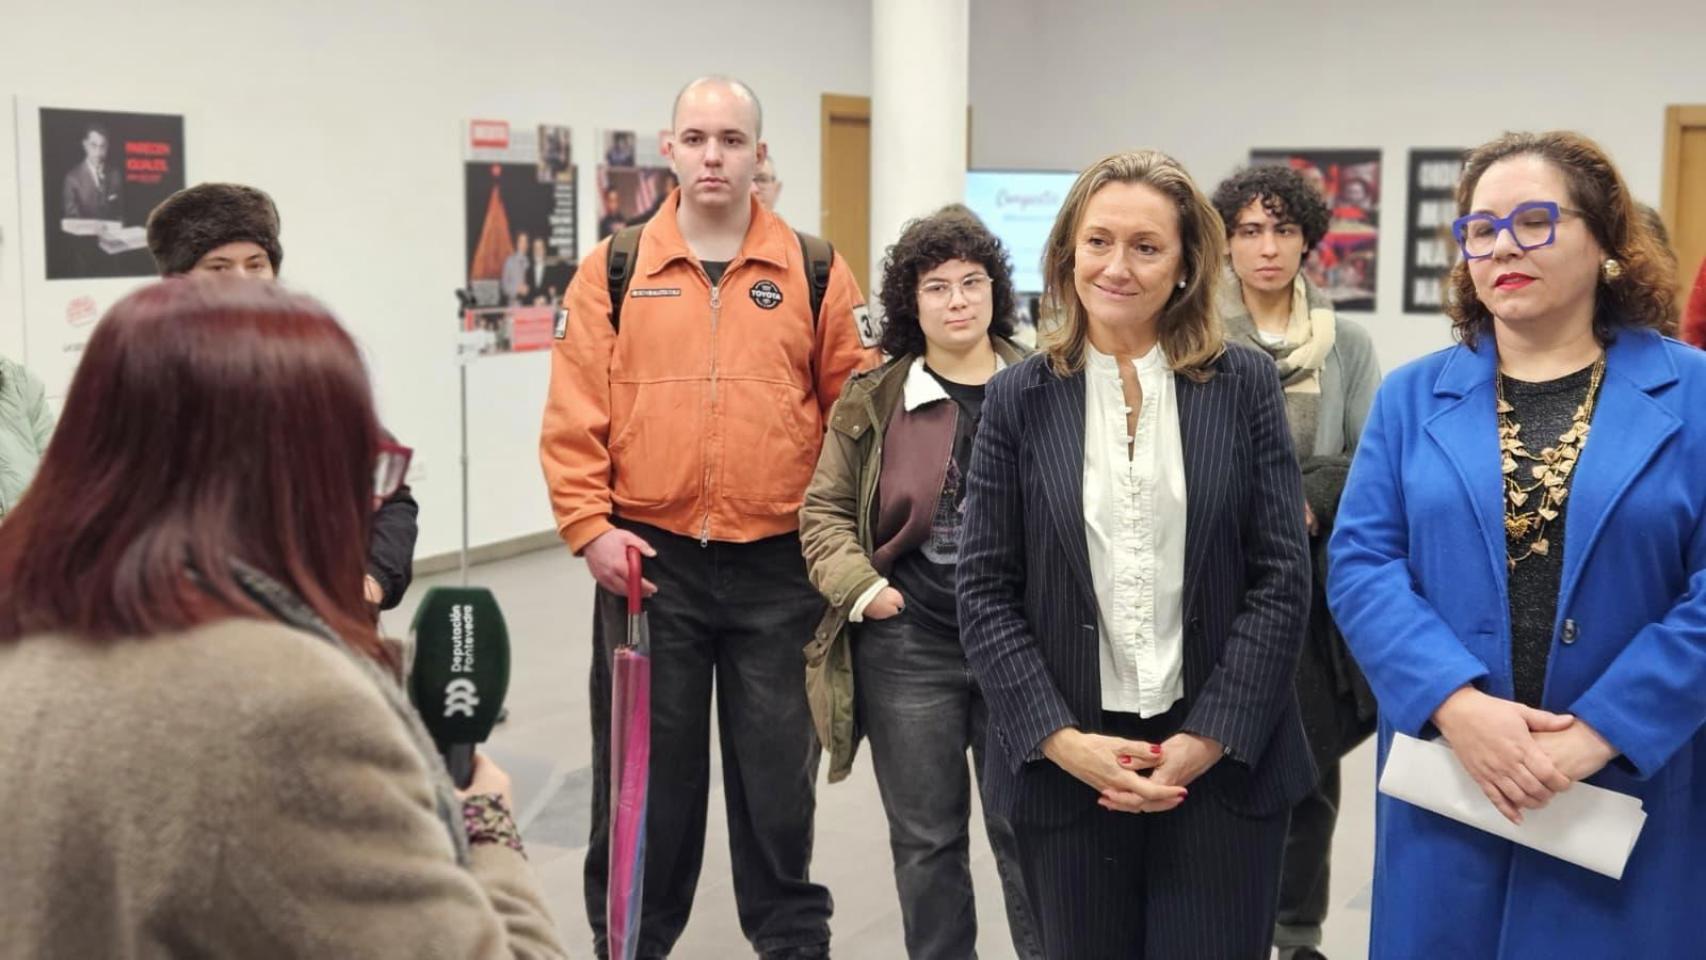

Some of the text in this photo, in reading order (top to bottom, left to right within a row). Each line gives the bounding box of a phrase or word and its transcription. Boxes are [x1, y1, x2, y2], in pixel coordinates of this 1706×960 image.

[751, 289, 781, 301] TOYOTA
[449, 604, 465, 672] Deputación
[463, 604, 474, 672] Pontevedra
